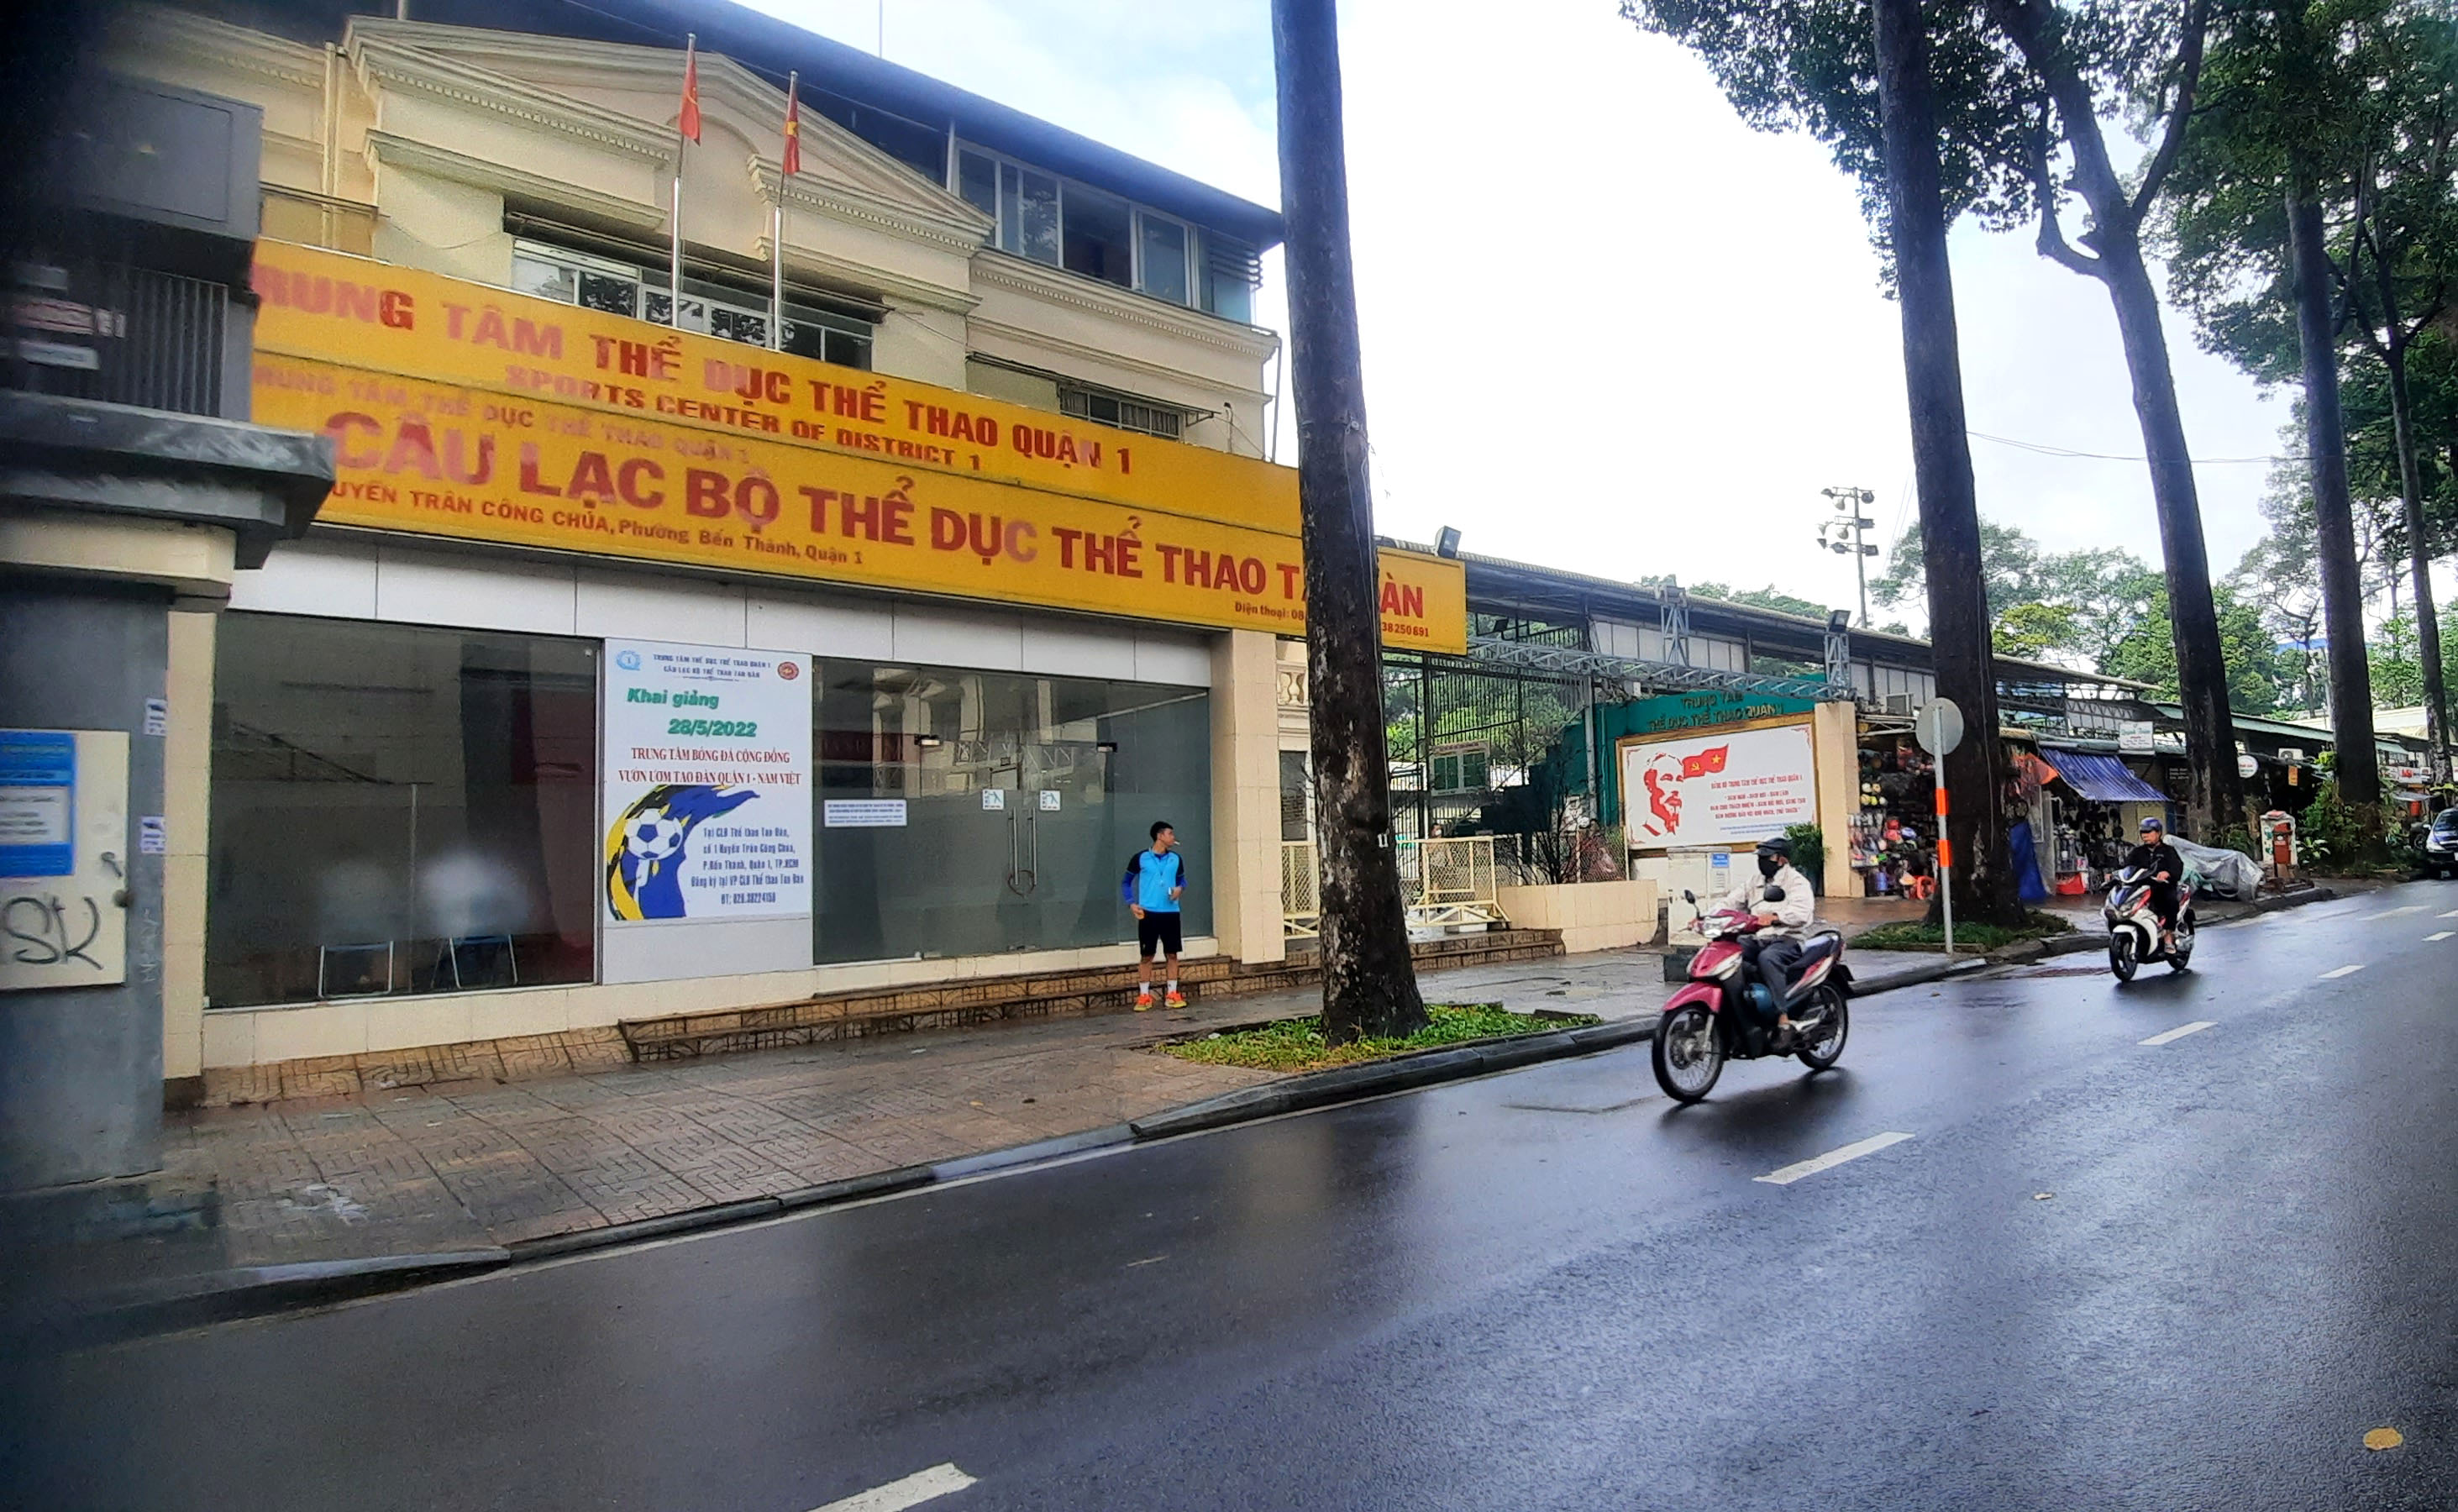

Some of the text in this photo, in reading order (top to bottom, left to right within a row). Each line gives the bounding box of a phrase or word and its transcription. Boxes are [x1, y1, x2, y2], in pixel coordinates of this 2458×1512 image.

[251, 261, 1131, 475] RUNG TÂM THỂ DỤC THỂ THAO QUẬN 1
[481, 403, 534, 429] DỤC
[601, 421, 664, 451] THAO
[504, 365, 981, 470] SPORTS CENTER OF DISTRICT 1
[323, 408, 497, 485] CÂU
[519, 441, 666, 509] LẠC
[685, 466, 780, 533] BỘ
[798, 475, 915, 546] THỂ
[931, 506, 1038, 568] DỤC
[1051, 516, 1143, 578] THỂ
[1155, 543, 1267, 595] THAO
[1379, 572, 1423, 619] ÀN
[481, 498, 544, 523] CÔNG
[699, 528, 733, 548] Bến
[805, 544, 848, 566] Quận
[853, 550, 864, 564] 1
[627, 687, 720, 710] Khai giảng
[667, 718, 758, 738] 28/5/2022
[631, 746, 790, 764] TRUNG TÂM BÓNG ĐÁ CỘNG ĐỒNG
[618, 767, 648, 783] VƯỜN
[649, 769, 672, 783] ƯƠM
[674, 770, 694, 784] TAO
[696, 769, 717, 784] ĐÀN
[717, 769, 744, 785] QUẬN
[758, 773, 778, 785] NAM
[779, 770, 802, 785] VIỆT
[716, 827, 728, 837] CLB
[761, 827, 773, 837] Tao
